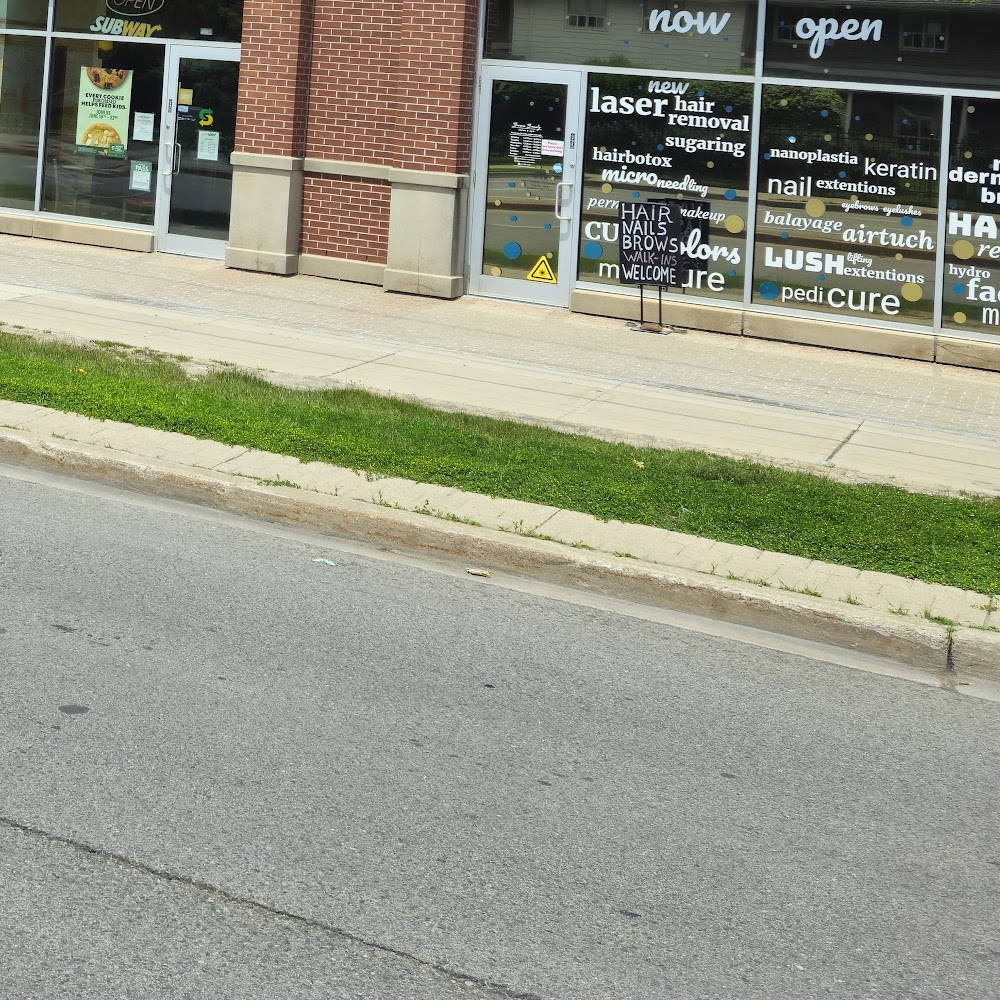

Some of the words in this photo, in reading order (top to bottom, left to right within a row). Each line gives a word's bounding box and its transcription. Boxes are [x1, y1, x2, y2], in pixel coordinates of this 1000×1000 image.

[90, 16, 162, 38] SUBWAY
[649, 8, 730, 35] now
[795, 17, 882, 59] open
[648, 80, 690, 95] new
[590, 87, 668, 118] laser
[674, 95, 715, 114] hair
[668, 113, 749, 132] removal
[592, 146, 673, 168] hairbotox
[665, 136, 746, 158] sugaring
[770, 148, 858, 165] nanoplastia
[864, 157, 937, 181] keratin
[768, 176, 812, 197] nail
[816, 179, 896, 196] extentions
[621, 203, 673, 223] HAIR
[841, 200, 879, 212] eyebrows
[622, 220, 666, 235] NAILS
[764, 211, 843, 233] balayage
[842, 224, 934, 250] airtuch
[622, 235, 678, 253] BROWS
[681, 228, 741, 265] lors
[765, 246, 844, 275] LUSH
[847, 252, 873, 267] lifting
[949, 264, 990, 279] hydro
[622, 264, 677, 285] WELCOME
[844, 266, 925, 284] extentions
[966, 278, 1000, 303] fa
